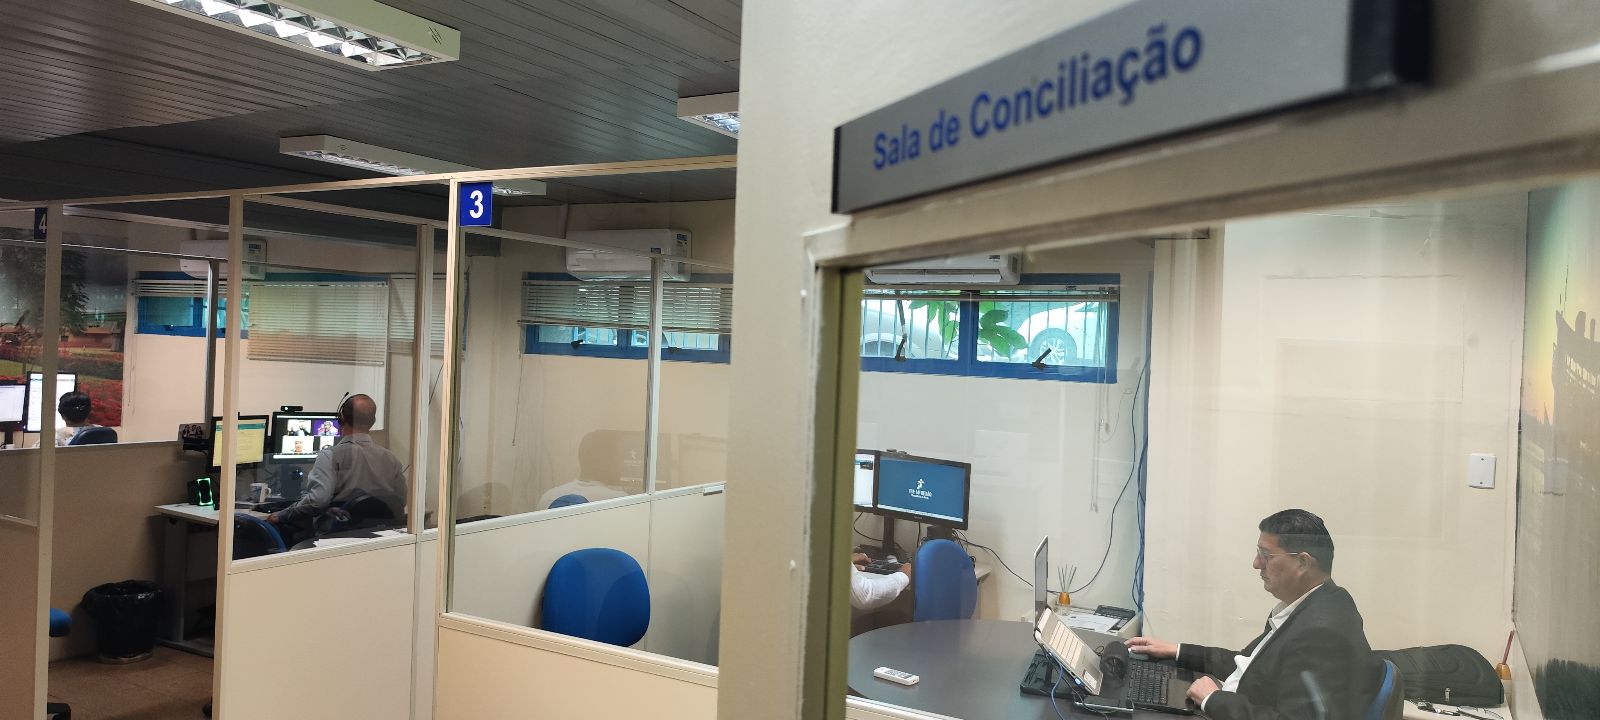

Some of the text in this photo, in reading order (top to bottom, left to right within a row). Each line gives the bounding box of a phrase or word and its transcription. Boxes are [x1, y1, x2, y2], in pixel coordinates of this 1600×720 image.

[873, 23, 1203, 170] Sala de Conciliação
[469, 190, 484, 219] 3
[38, 213, 48, 234] 4
